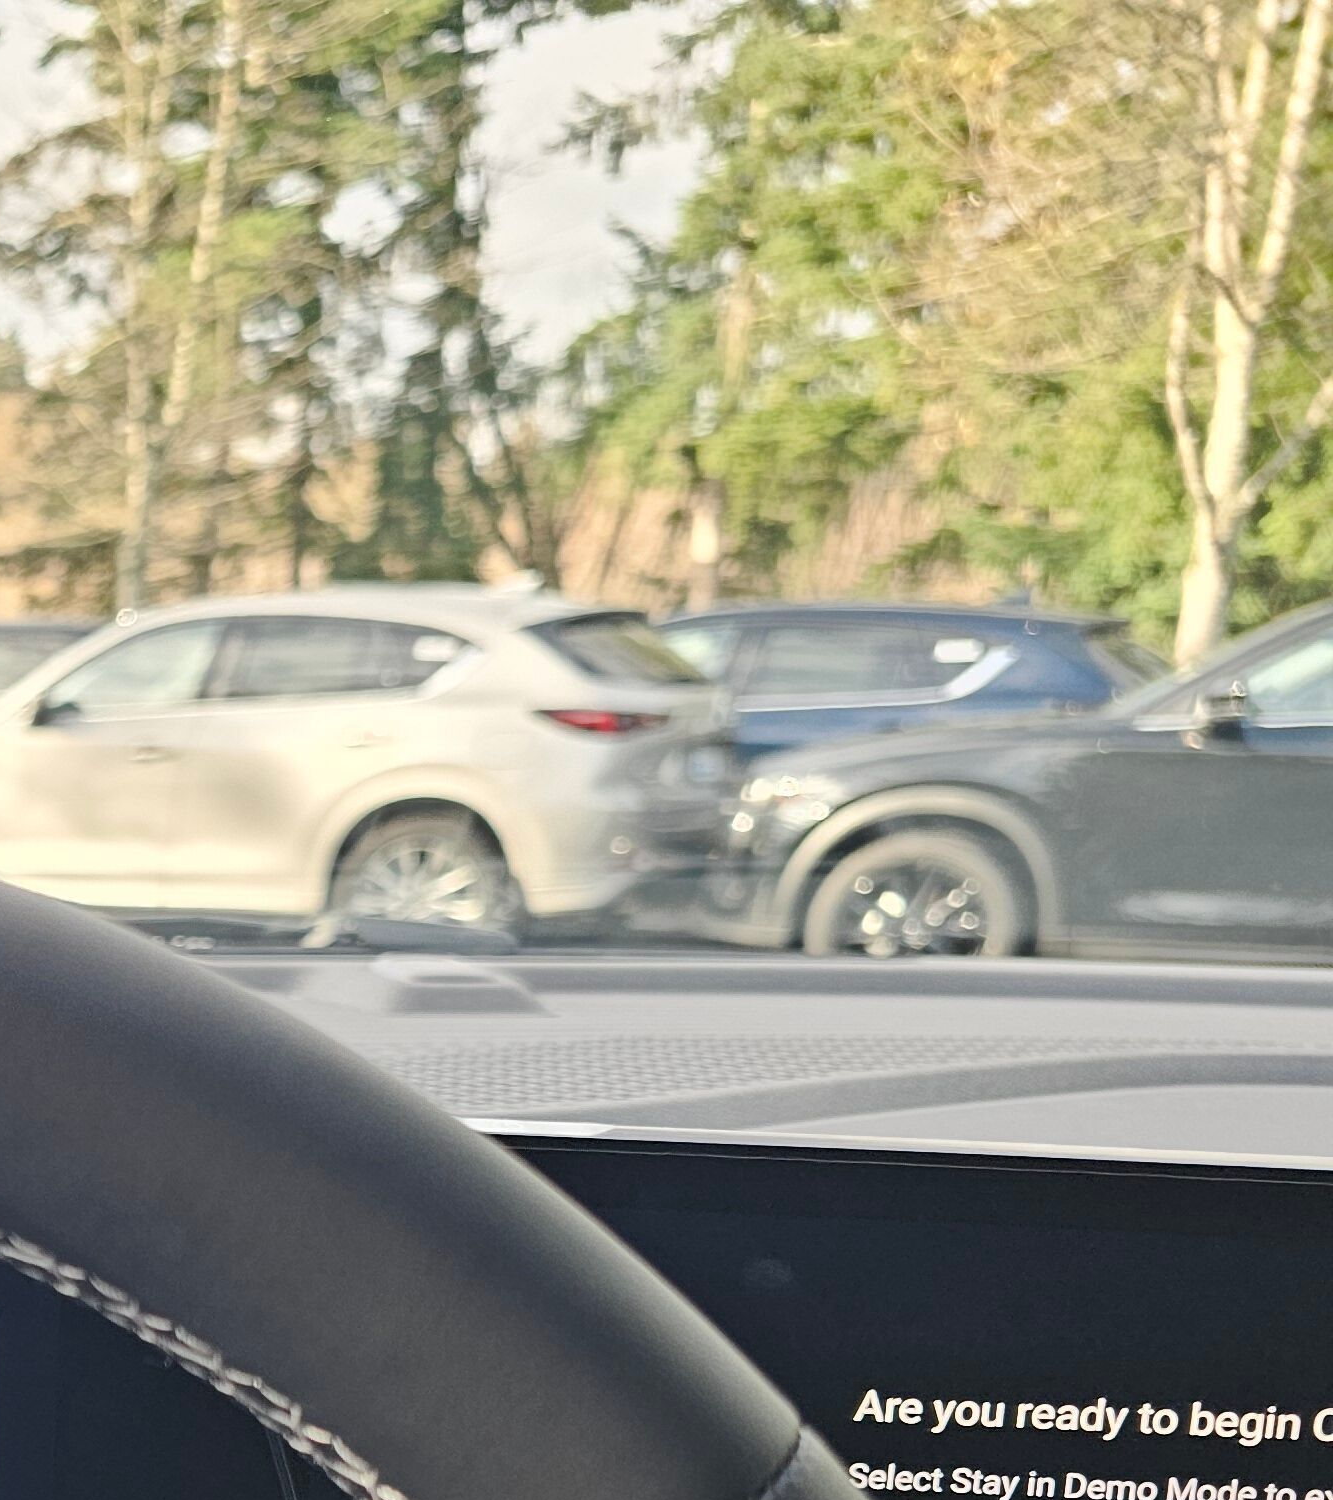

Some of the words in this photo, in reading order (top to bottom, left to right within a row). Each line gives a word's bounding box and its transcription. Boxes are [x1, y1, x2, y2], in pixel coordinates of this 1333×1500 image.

[852, 1388, 924, 1425] Are
[930, 1399, 1006, 1434] you
[1015, 1397, 1130, 1441] ready
[1136, 1402, 1179, 1435] to
[1188, 1400, 1302, 1447] begin
[848, 1462, 944, 1495] Select
[1026, 1470, 1056, 1498] in
